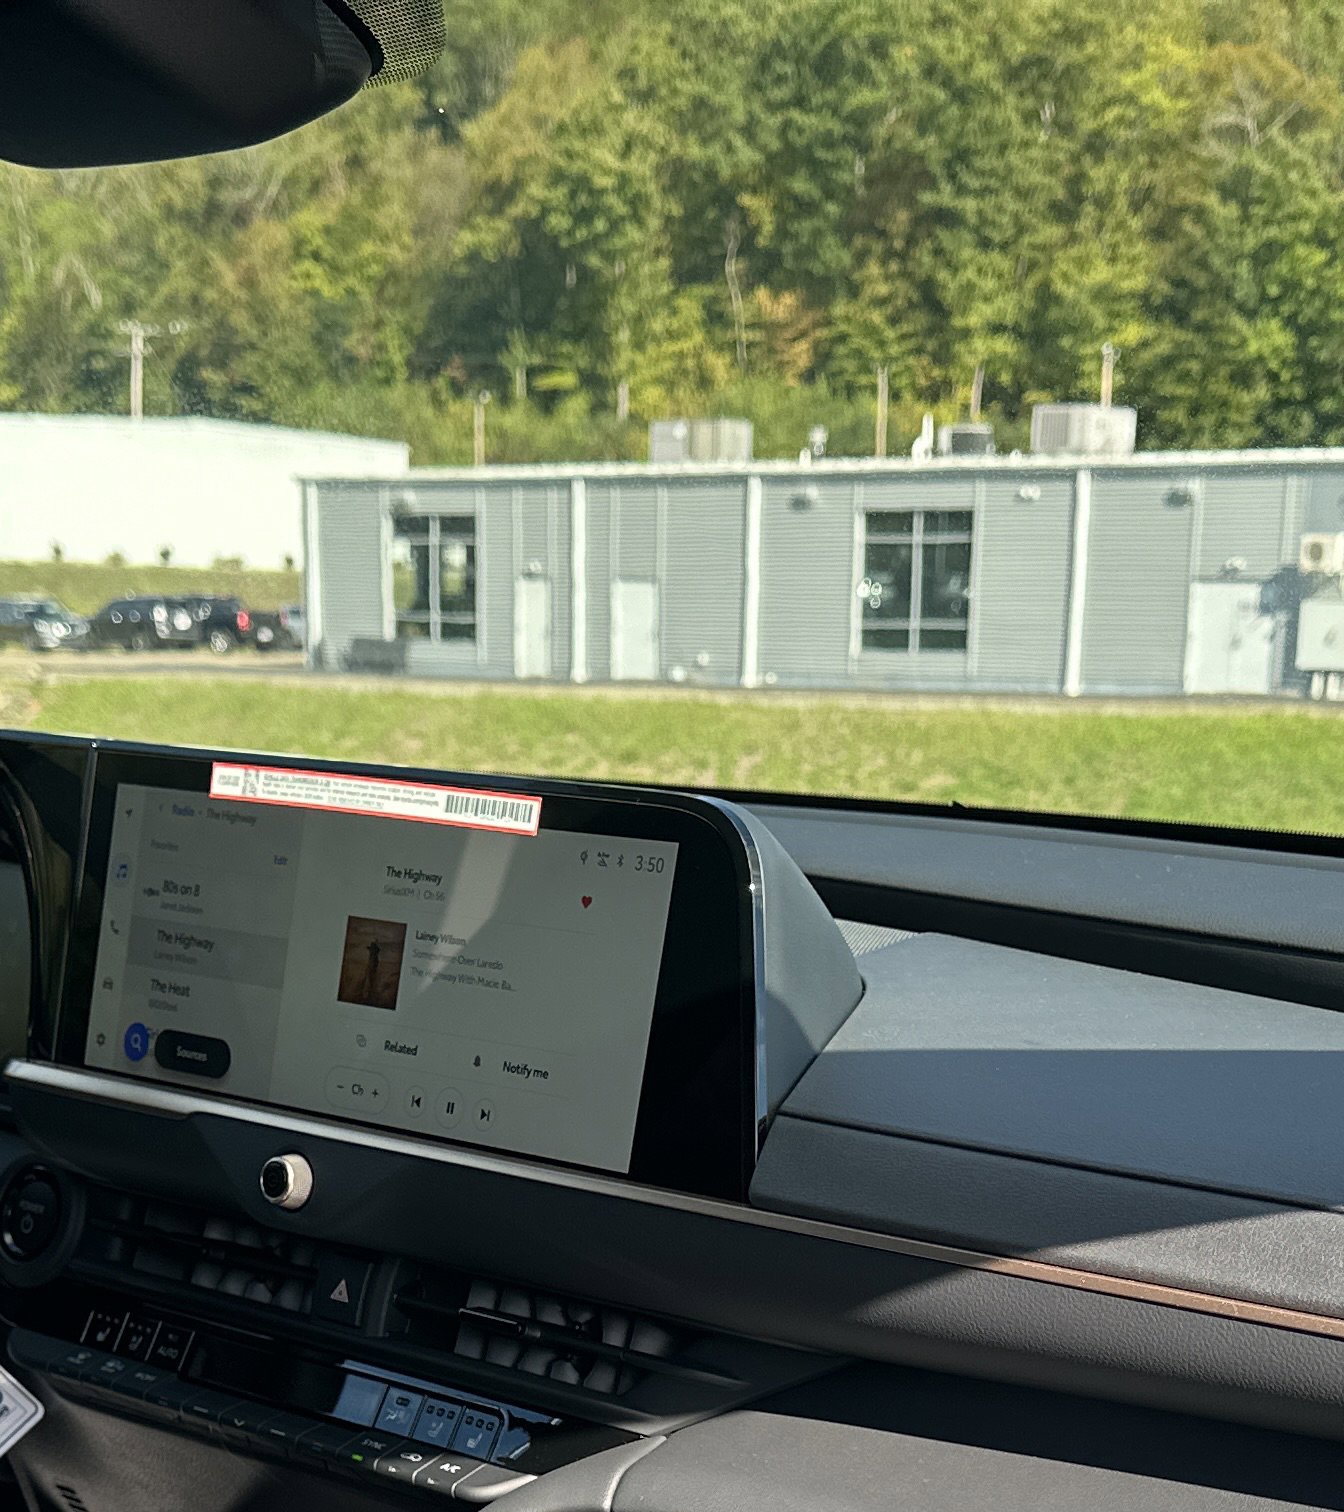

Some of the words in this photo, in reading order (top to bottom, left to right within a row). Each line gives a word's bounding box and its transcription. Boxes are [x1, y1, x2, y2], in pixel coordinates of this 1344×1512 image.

[207, 807, 223, 820] The
[225, 810, 257, 826] Highway
[634, 855, 665, 874] 3:50
[386, 865, 402, 879] The
[404, 868, 443, 886] Highway
[157, 929, 173, 944] The
[175, 932, 215, 952] Highway
[415, 930, 439, 945] Lainey
[440, 934, 466, 946] Wilson
[150, 979, 167, 993] The
[168, 983, 190, 998] Heat
[384, 1039, 419, 1056] Related
[502, 1060, 532, 1079] Notify
[532, 1068, 549, 1080] me
